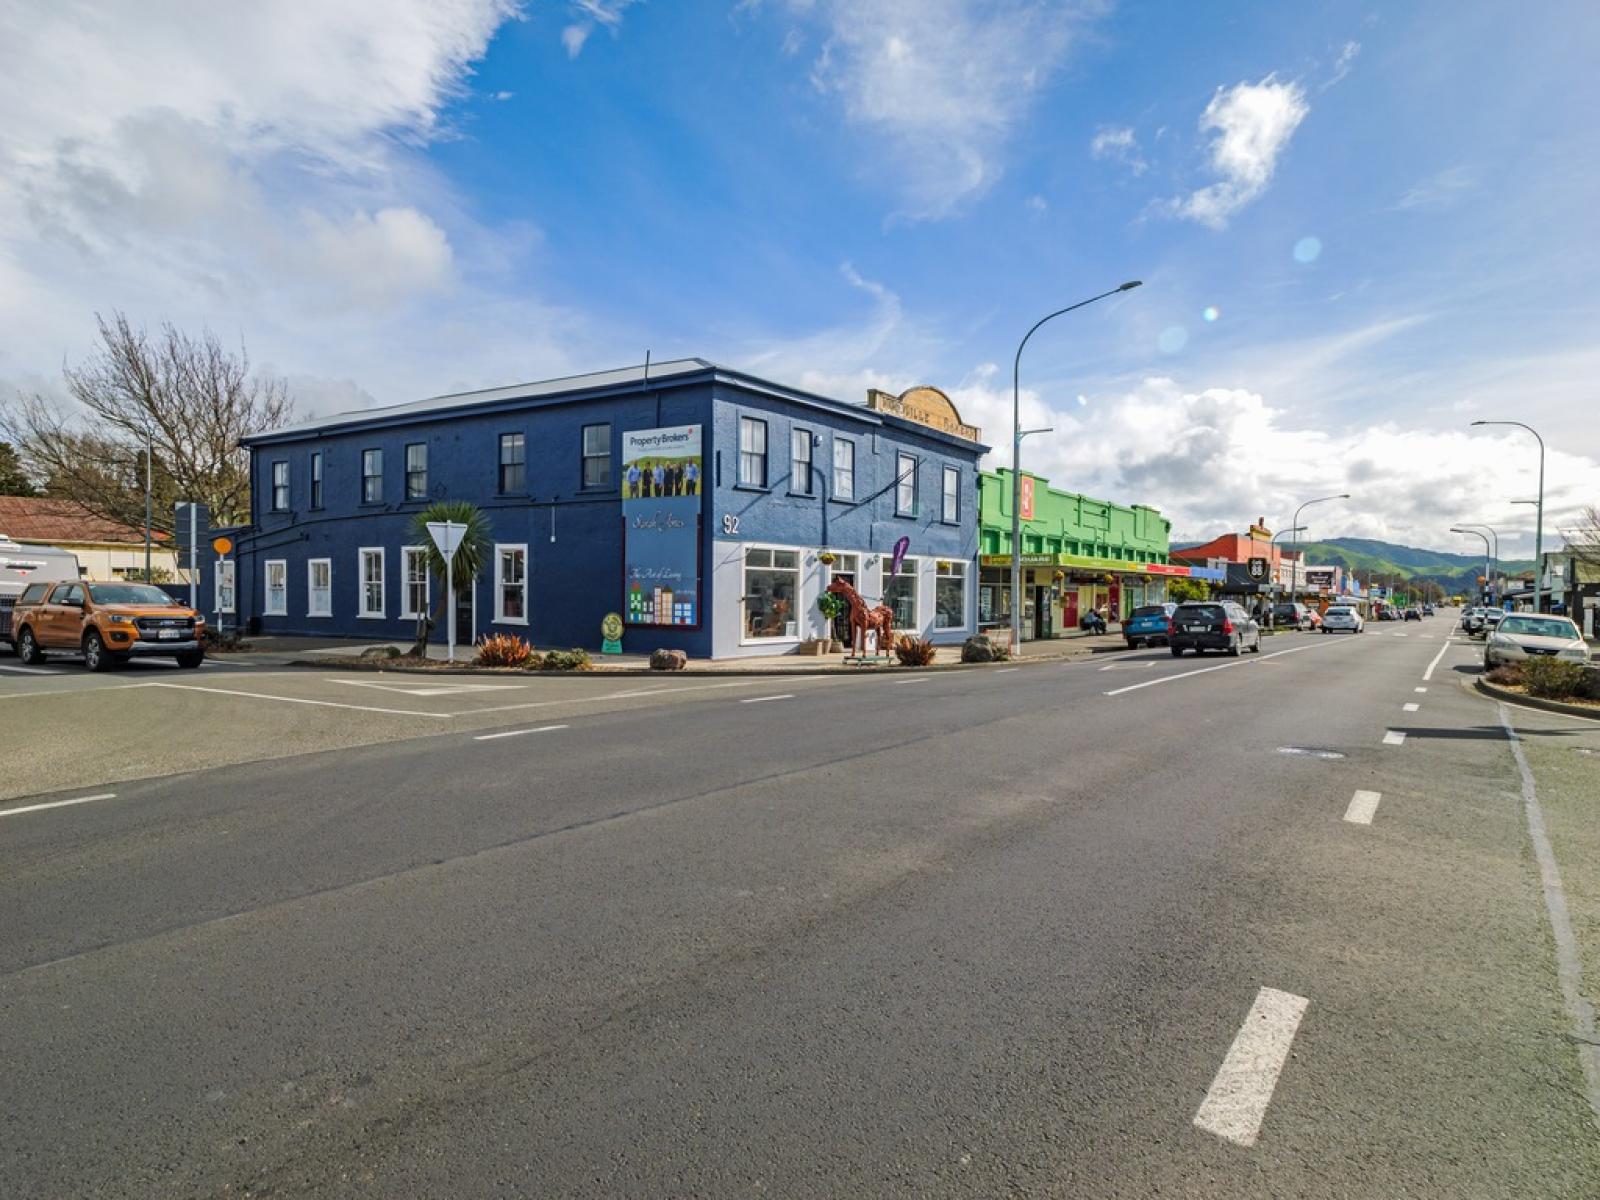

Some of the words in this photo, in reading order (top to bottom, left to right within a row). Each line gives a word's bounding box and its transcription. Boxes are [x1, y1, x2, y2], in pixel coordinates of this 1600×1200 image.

[630, 435, 660, 447] Property
[662, 433, 689, 443] Brokers
[723, 514, 740, 534] 92
